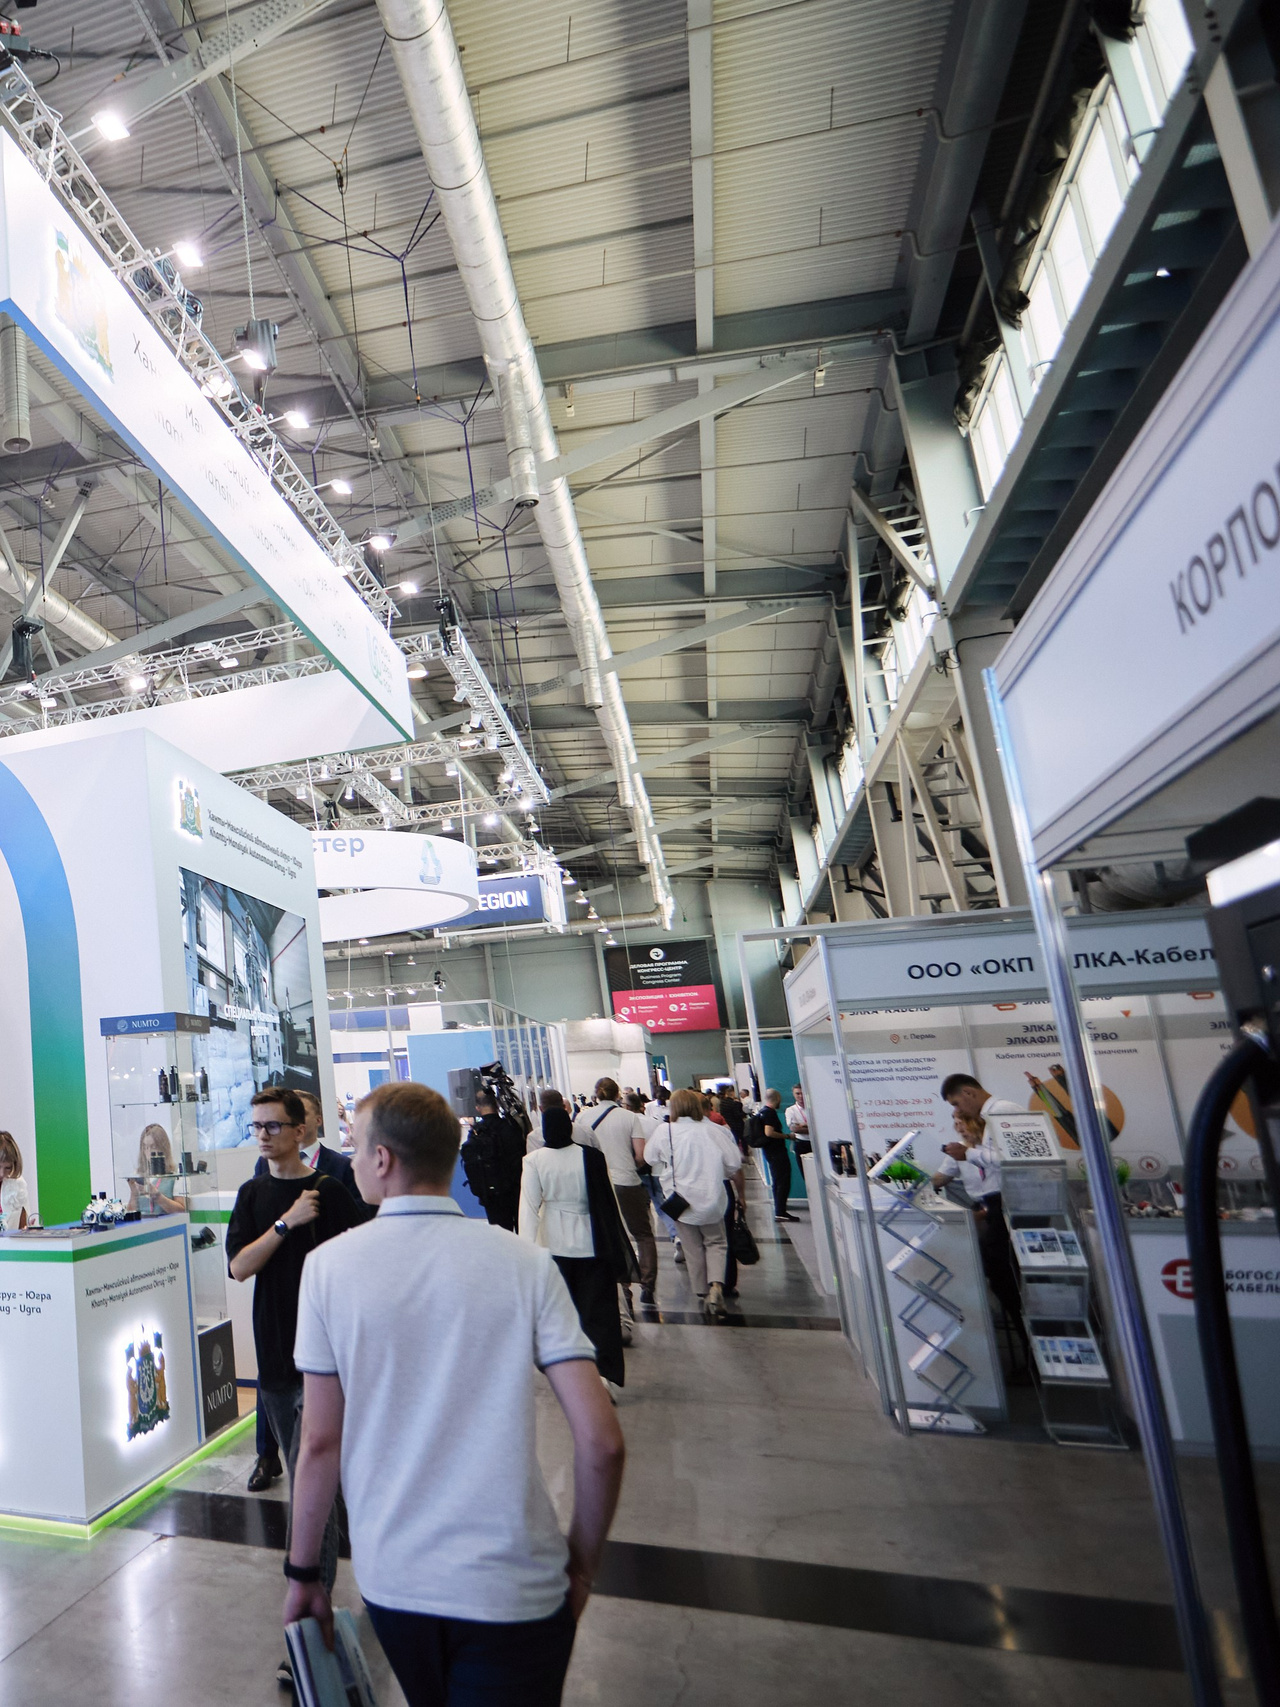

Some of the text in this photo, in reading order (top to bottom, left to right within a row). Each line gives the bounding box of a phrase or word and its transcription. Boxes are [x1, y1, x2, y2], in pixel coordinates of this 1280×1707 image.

[1170, 459, 1280, 635] КОРПО
[476, 889, 529, 911] EGION
[907, 946, 1215, 980] ООО «ОКП ЛКА-Кабел
[637, 965, 683, 973] КОНГРЕСС-ЦЕНТР
[631, 1006, 637, 1014] 1
[680, 1003, 688, 1011] 2
[131, 1018, 160, 1029] NUMTO
[657, 1018, 666, 1026] 4
[910, 1032, 936, 1041] Пермь
[995, 1052, 1025, 1060] Кабели
[1027, 1052, 1061, 1060] специал
[882, 1056, 937, 1066] производство
[895, 1064, 934, 1072] кабельно-
[895, 1074, 939, 1083] продукции
[875, 1099, 893, 1107] (342)
[867, 1110, 933, 1118] info@okp-perm.ru
[25, 1290, 52, 1303] Югра
[19, 1304, 42, 1316] Ugra
[207, 1382, 233, 1413] NUMTO
